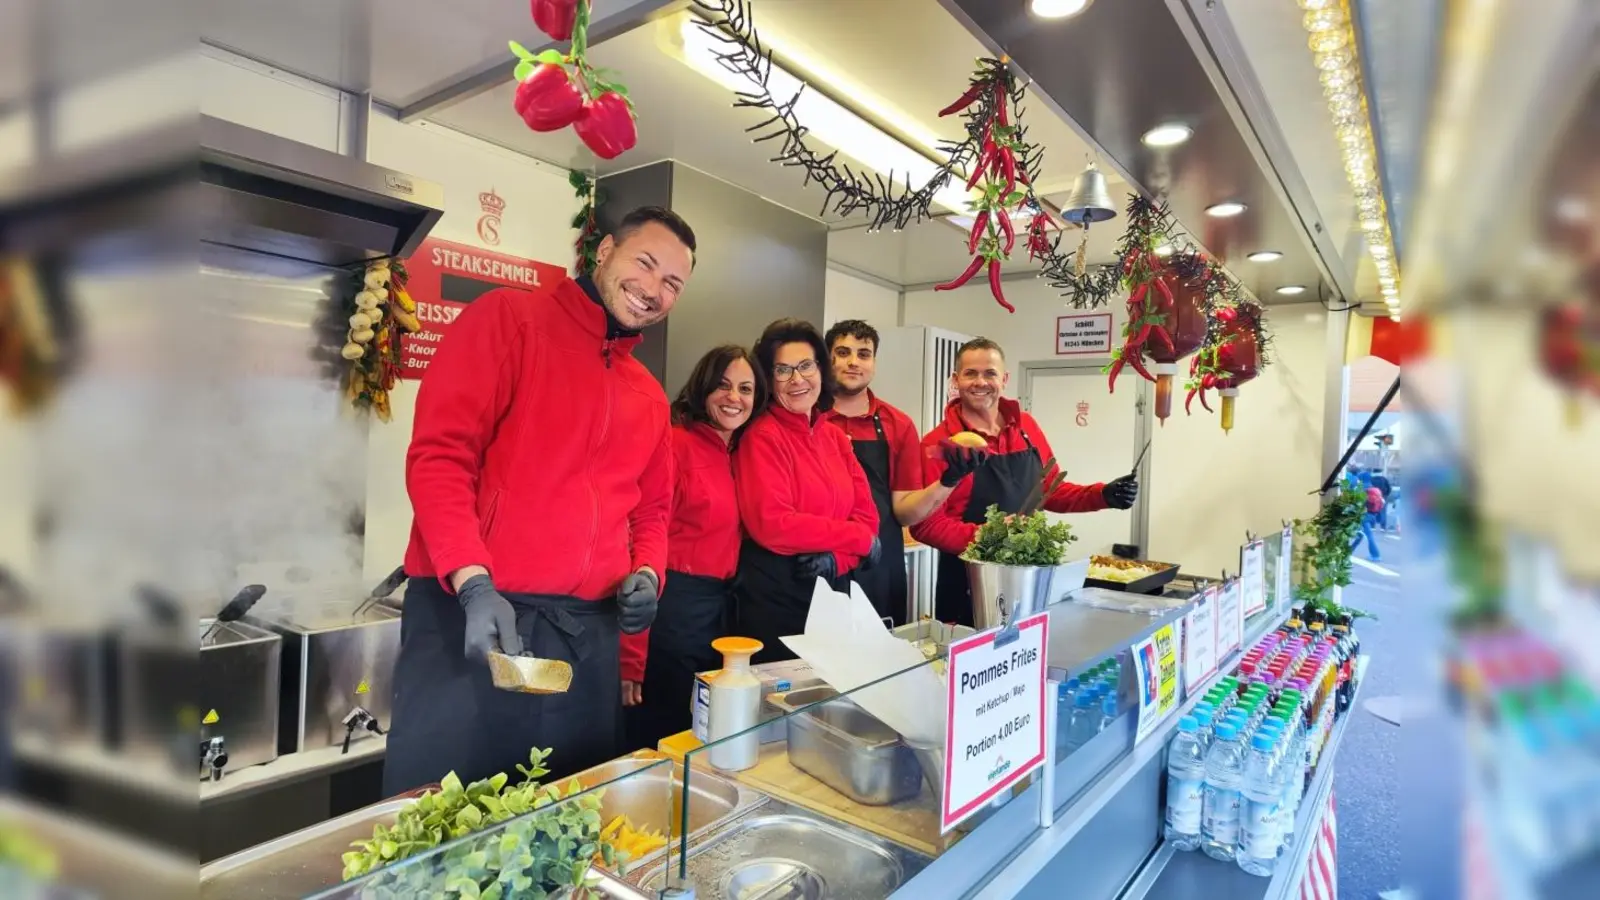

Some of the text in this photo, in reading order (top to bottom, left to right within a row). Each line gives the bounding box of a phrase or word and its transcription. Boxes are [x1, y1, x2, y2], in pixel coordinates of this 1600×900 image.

[431, 247, 541, 287] STEAKSEMMEL
[417, 301, 462, 325] EISS
[961, 647, 1037, 694] Pommes Frites
[976, 703, 986, 717] mit
[987, 693, 1009, 711] Ketchup
[1013, 684, 1025, 697] Majo
[966, 713, 1031, 761] Portion 4,00 Euro
